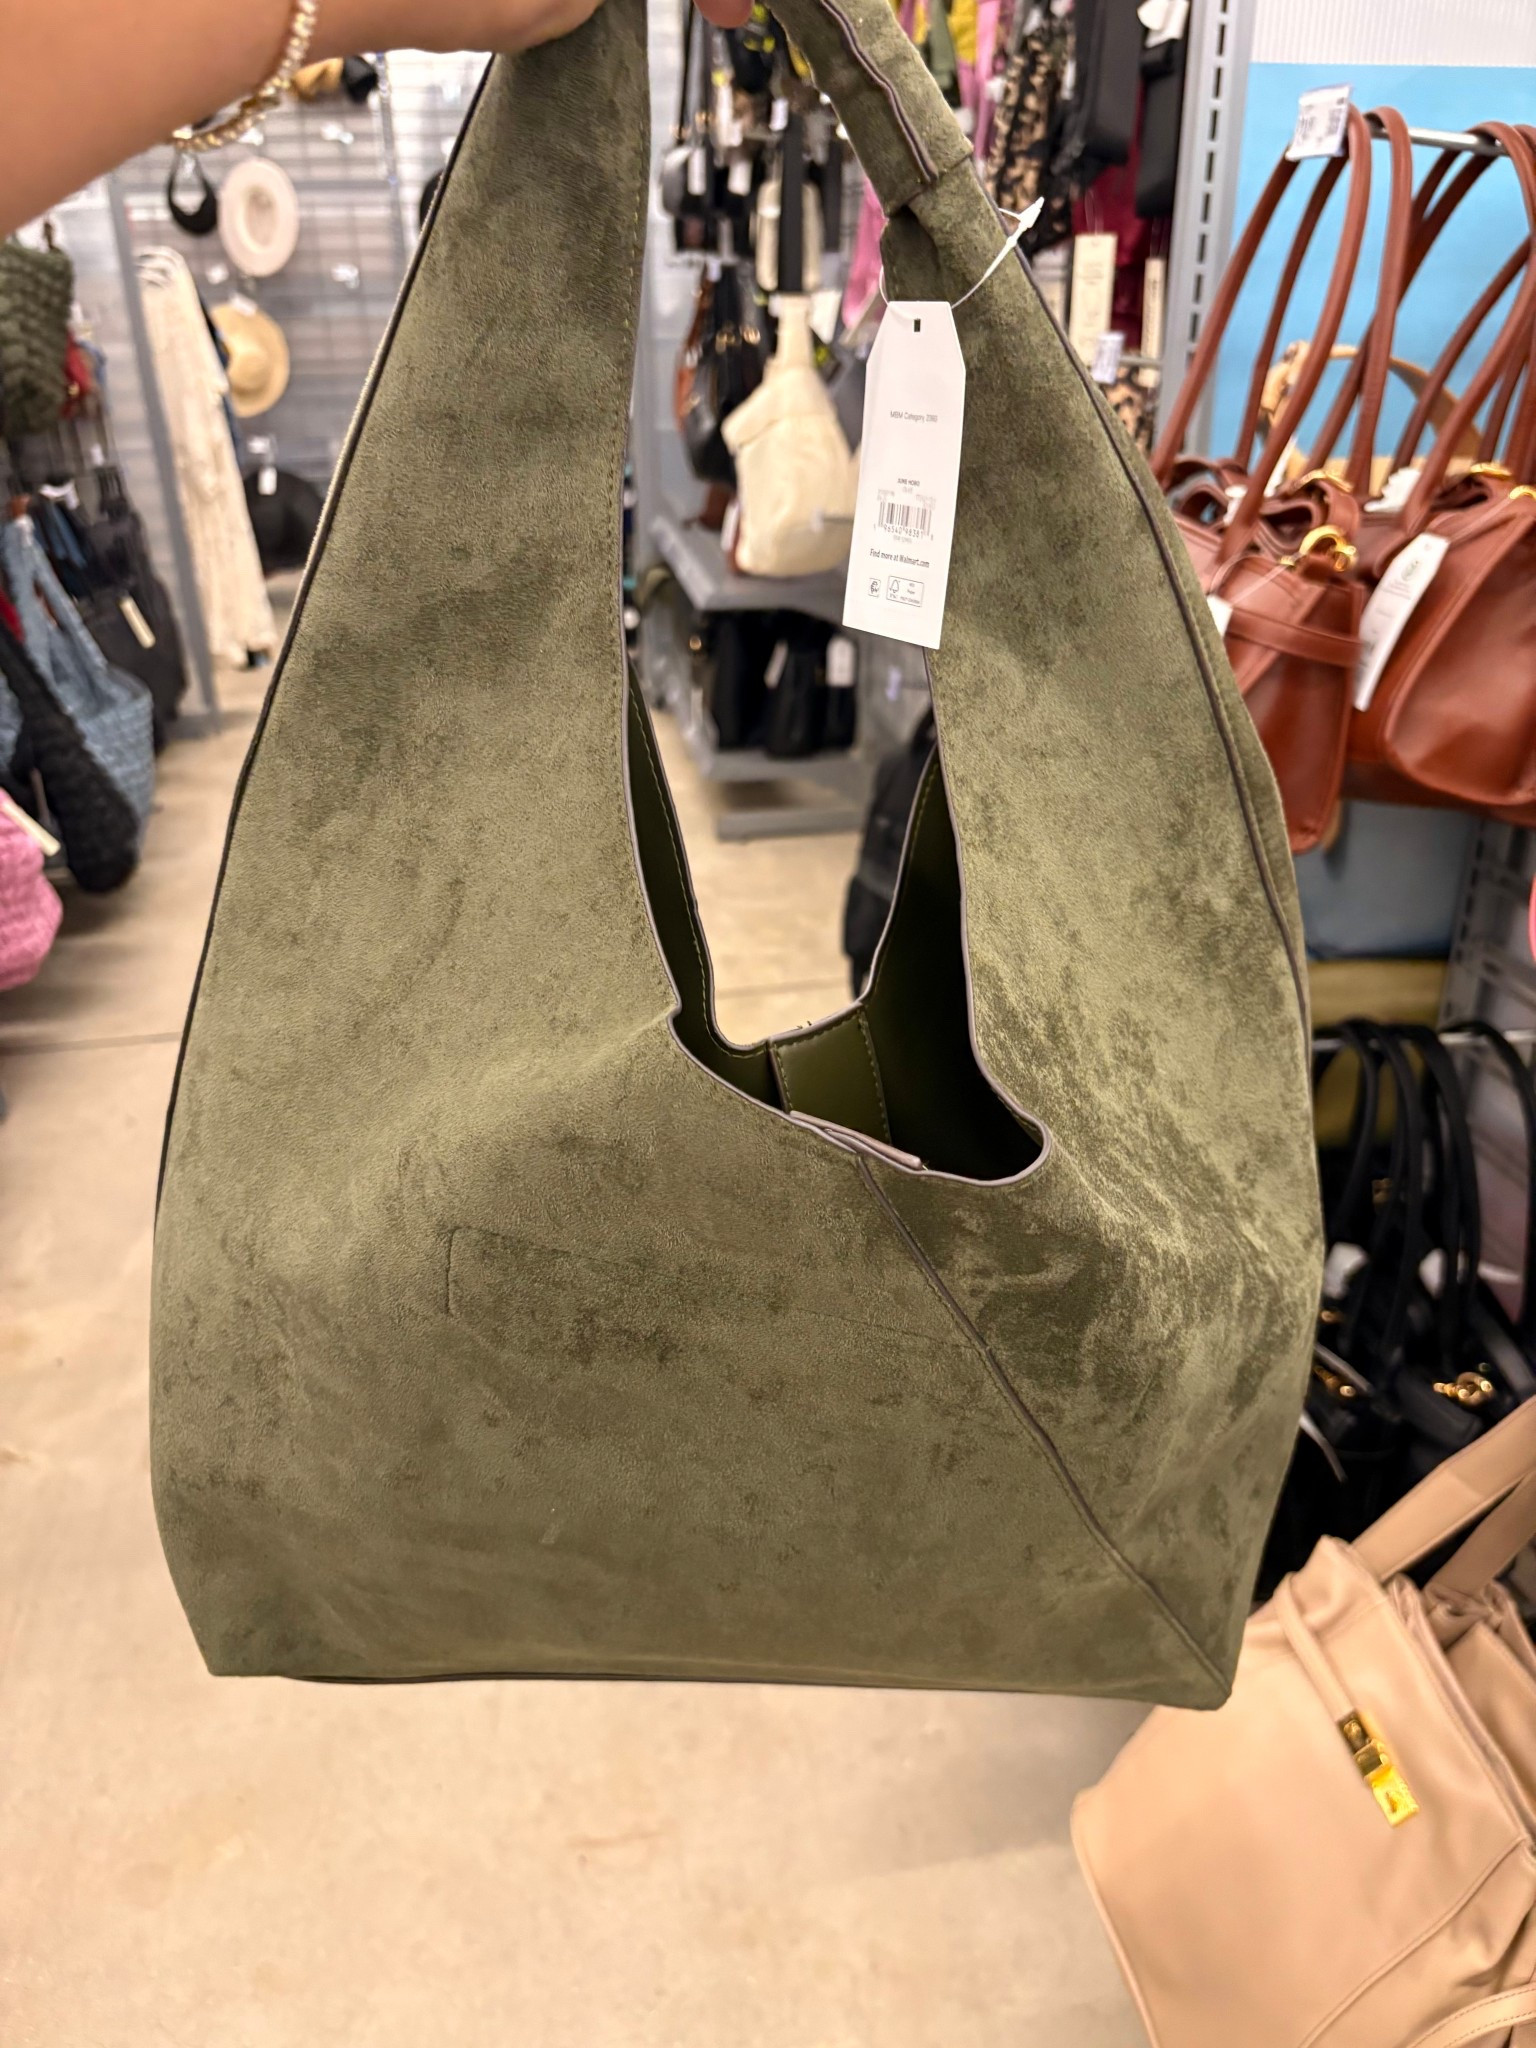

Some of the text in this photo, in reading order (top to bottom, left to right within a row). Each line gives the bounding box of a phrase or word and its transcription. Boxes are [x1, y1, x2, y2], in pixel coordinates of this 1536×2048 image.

[904, 411, 925, 423] Category
[870, 548, 880, 558] Find
[880, 552, 892, 560] more
[899, 554, 930, 568] Walmart.com
